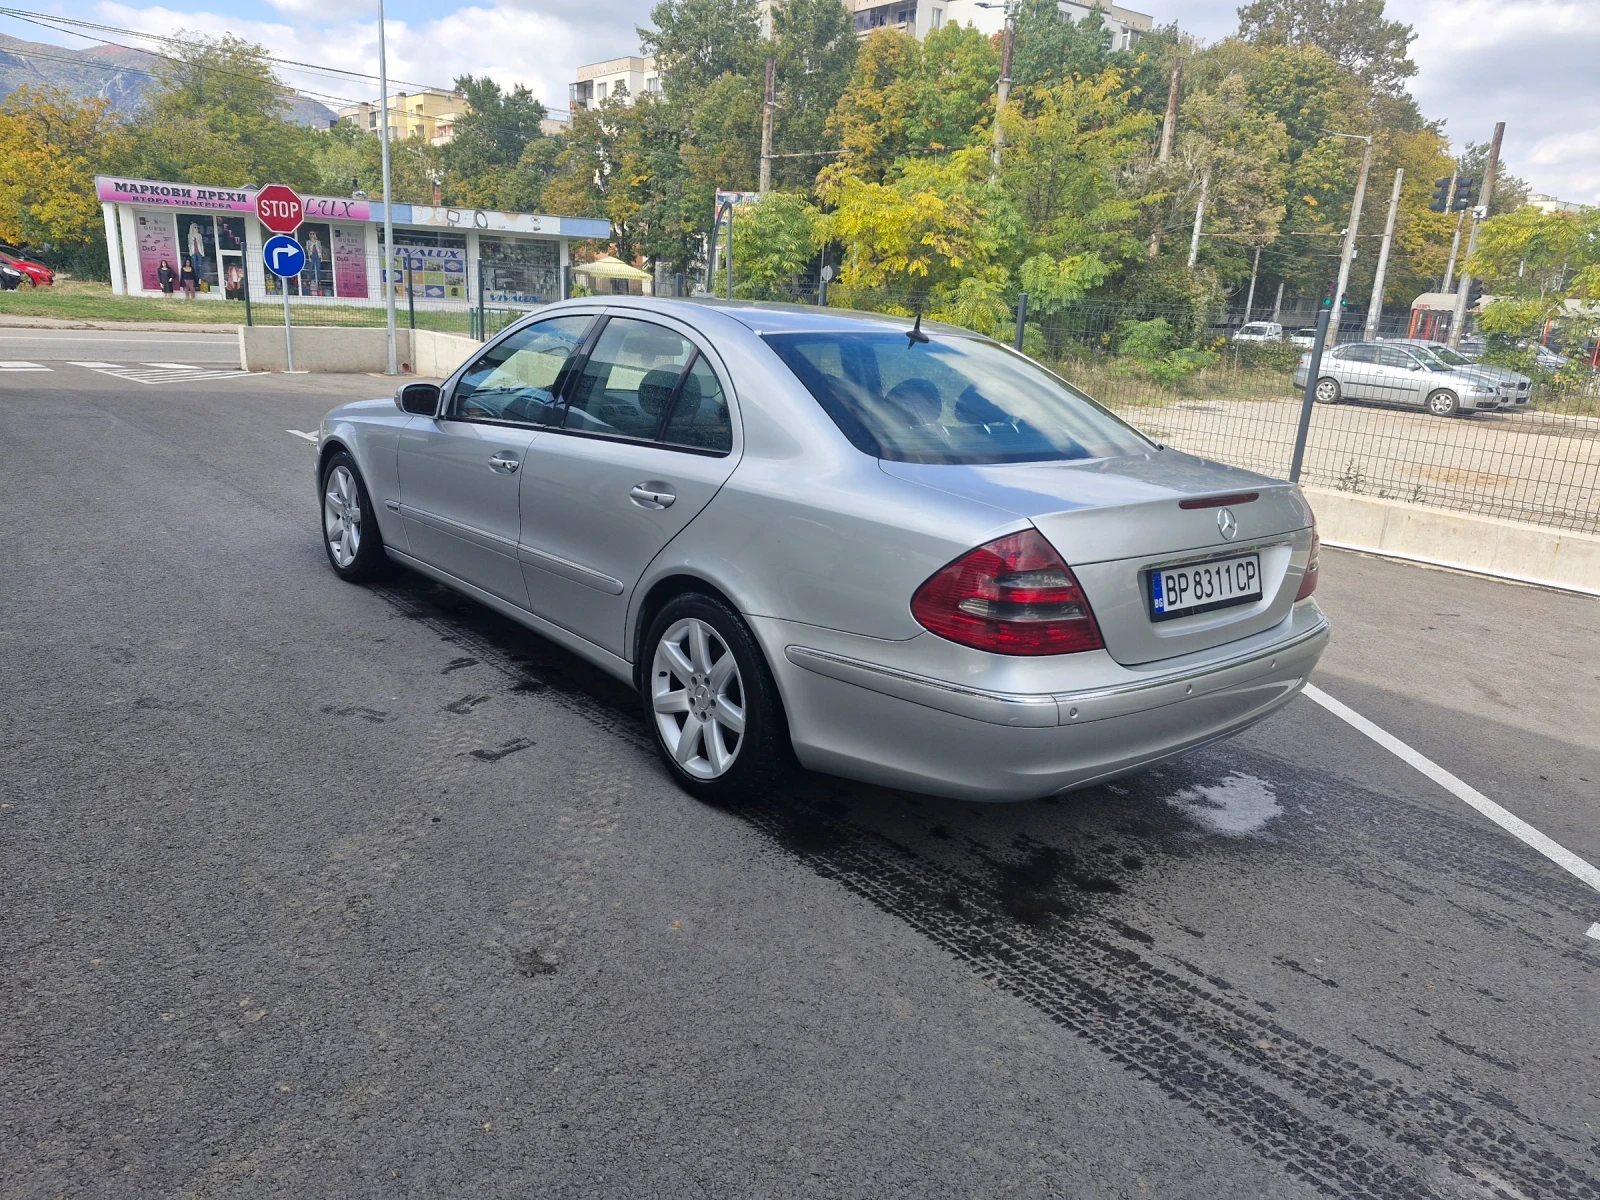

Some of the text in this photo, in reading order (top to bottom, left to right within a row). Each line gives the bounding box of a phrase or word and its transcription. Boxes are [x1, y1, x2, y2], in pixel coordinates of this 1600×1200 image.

[114, 182, 247, 203] МАРКОВИ ДРЕХИ
[131, 196, 232, 209] ВТОРА УПОТРЕБА
[261, 199, 299, 218] STOP
[304, 198, 355, 218] LUX
[489, 294, 540, 303] VIVALUX
[1165, 560, 1256, 606] BP 8311 CP
[1154, 597, 1164, 609] BG
